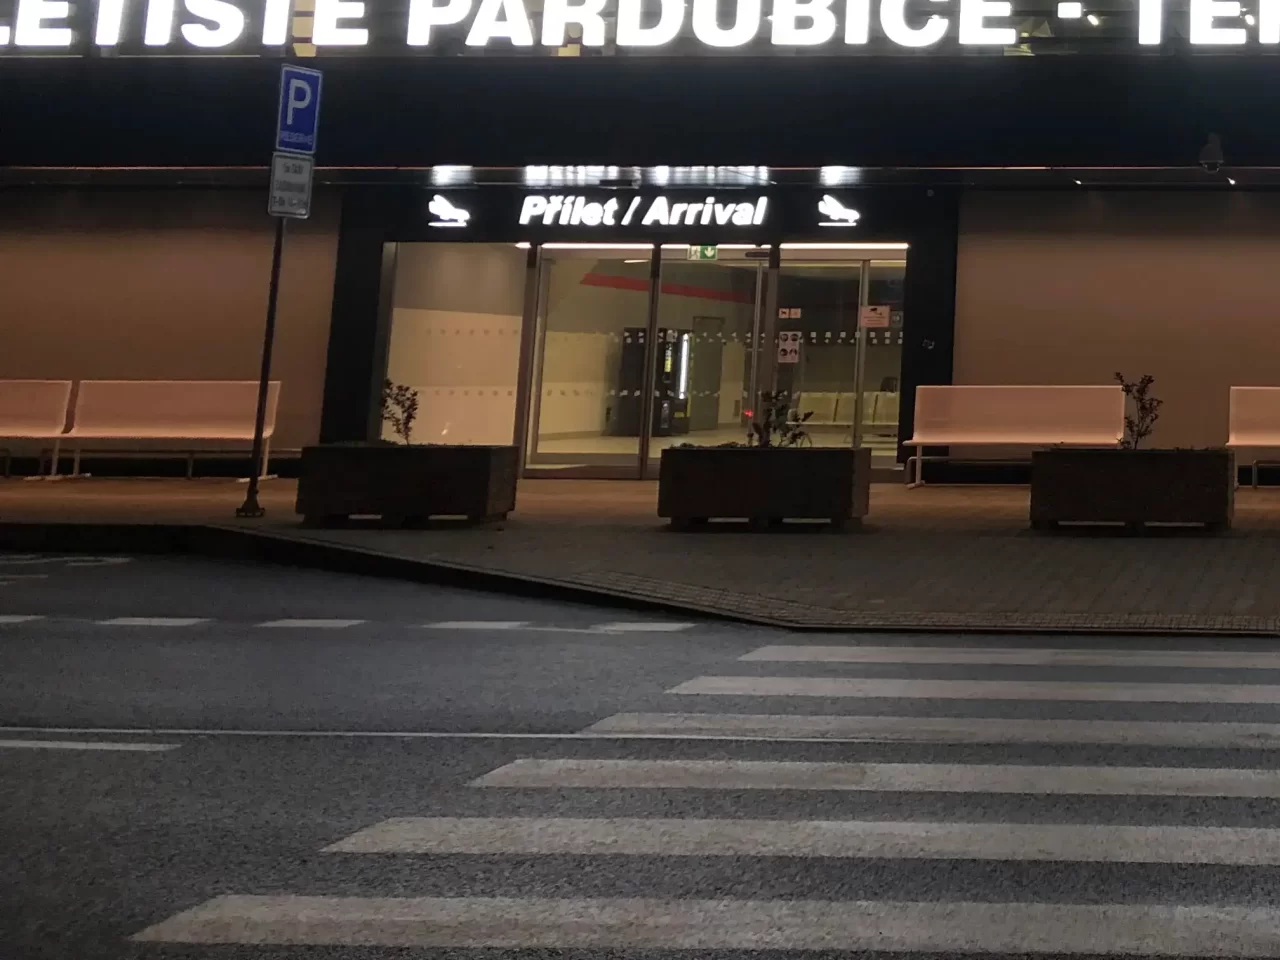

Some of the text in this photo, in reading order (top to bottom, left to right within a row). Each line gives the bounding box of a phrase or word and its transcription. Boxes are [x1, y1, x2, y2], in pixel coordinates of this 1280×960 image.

[1058, 2, 1082, 18] -
[286, 78, 312, 125] P
[518, 195, 768, 226] Přílet / Arrival
